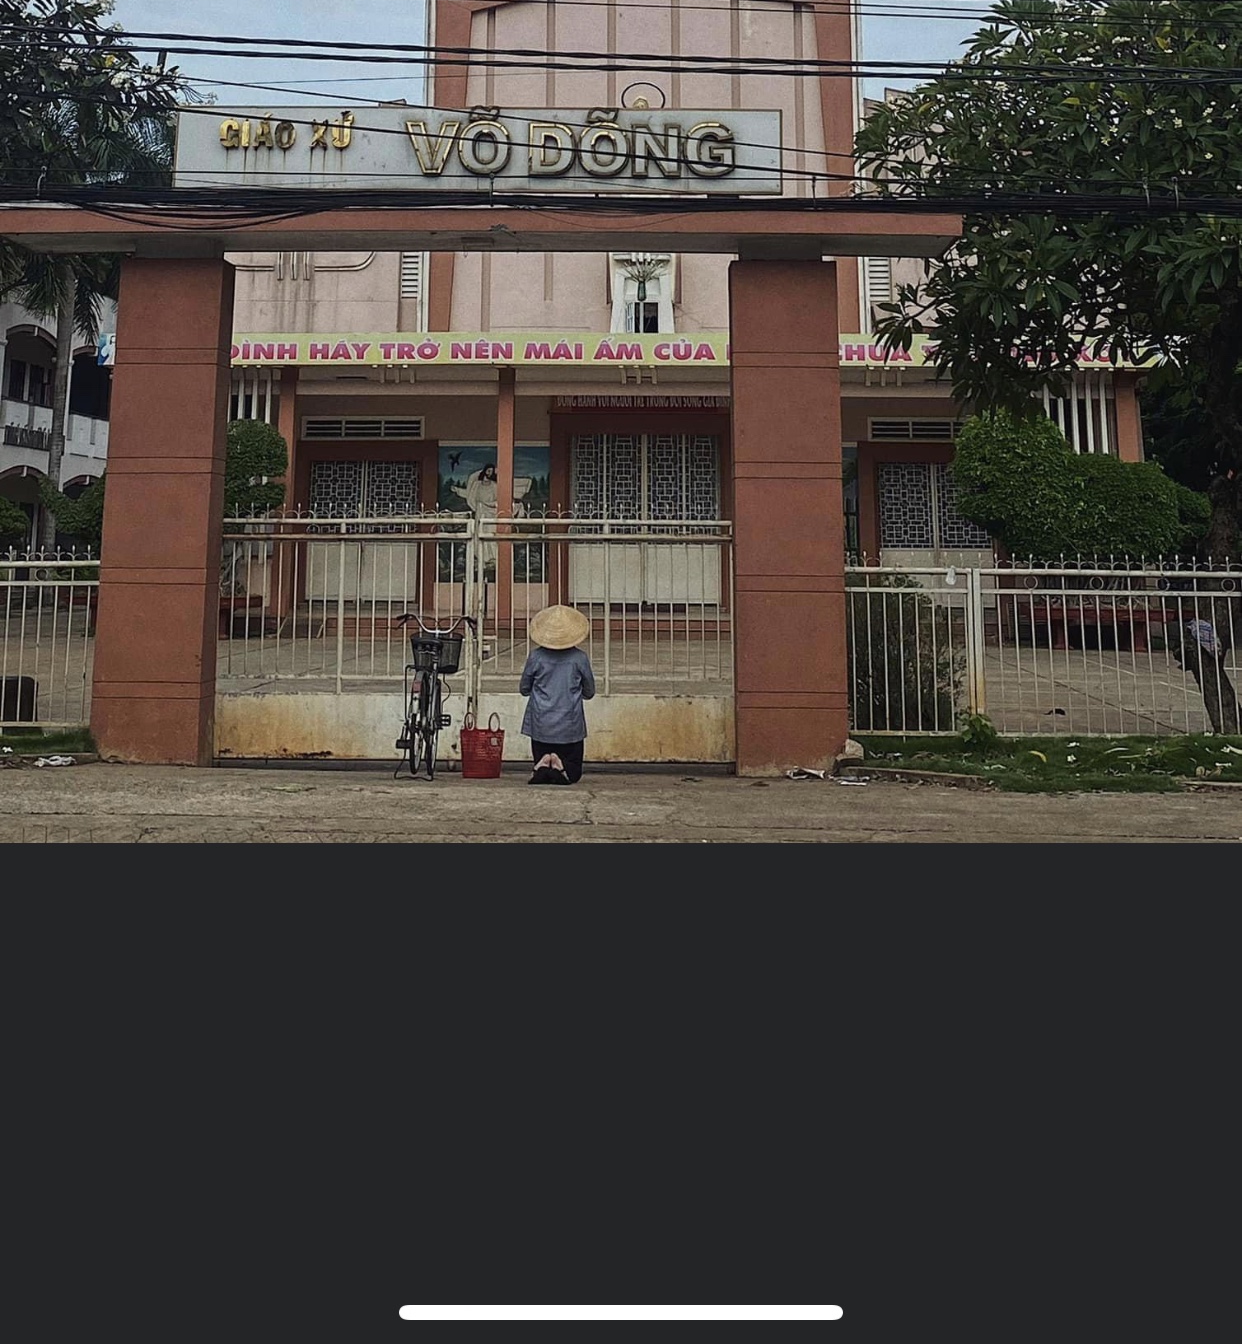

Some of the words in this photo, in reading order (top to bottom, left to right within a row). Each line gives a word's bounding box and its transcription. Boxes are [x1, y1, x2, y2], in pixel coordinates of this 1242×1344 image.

[219, 112, 297, 150] GIÁO
[405, 105, 512, 177] VÕ
[527, 107, 736, 178] DÕNG
[379, 337, 441, 360] TRỞ
[450, 338, 513, 360] NÊN
[524, 339, 583, 360] MÁI
[593, 337, 644, 360] ẤM
[653, 338, 716, 360] CỦA
